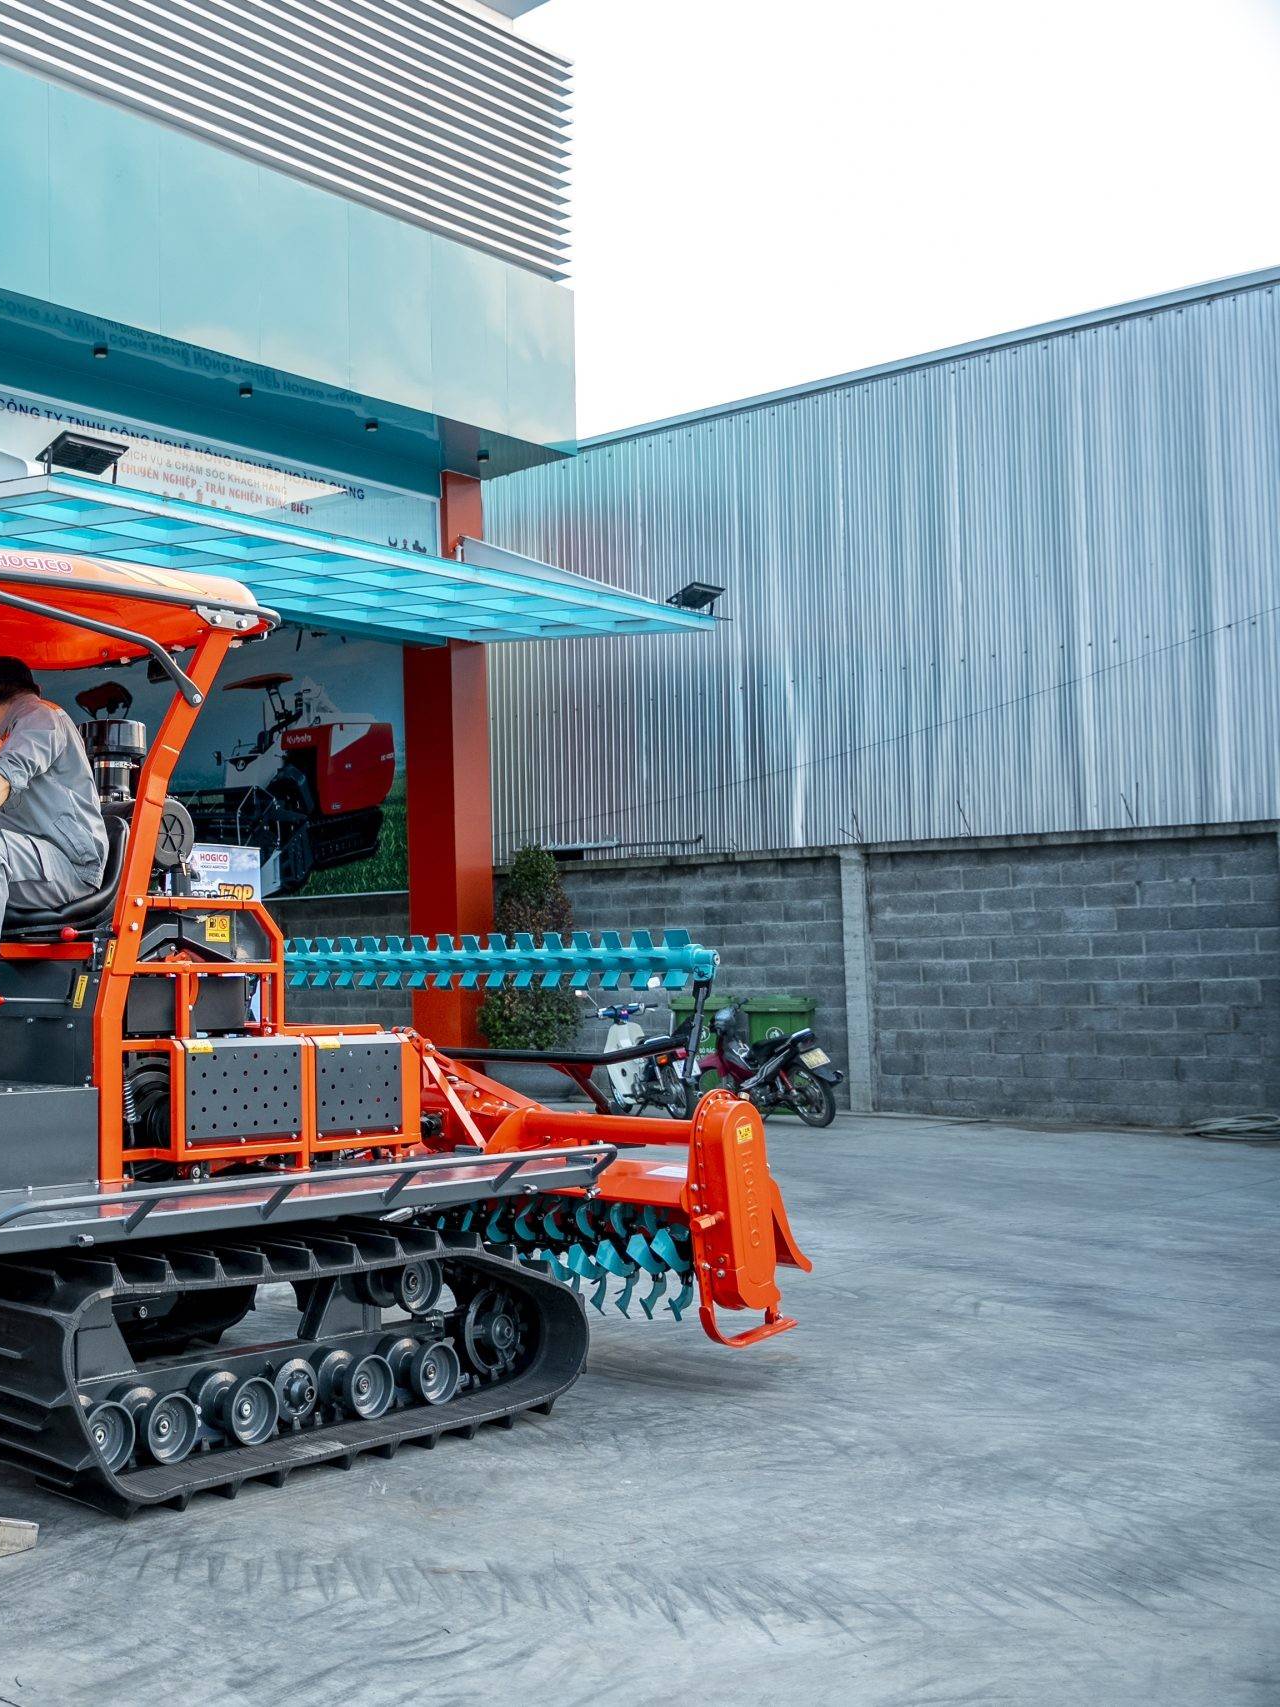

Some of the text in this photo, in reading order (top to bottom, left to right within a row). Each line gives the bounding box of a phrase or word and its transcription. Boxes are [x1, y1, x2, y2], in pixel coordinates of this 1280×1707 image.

[44, 410, 62, 425] TY
[287, 733, 312, 744] Kubota
[200, 854, 228, 863] HOGICO
[741, 1150, 760, 1247] HOGICO
